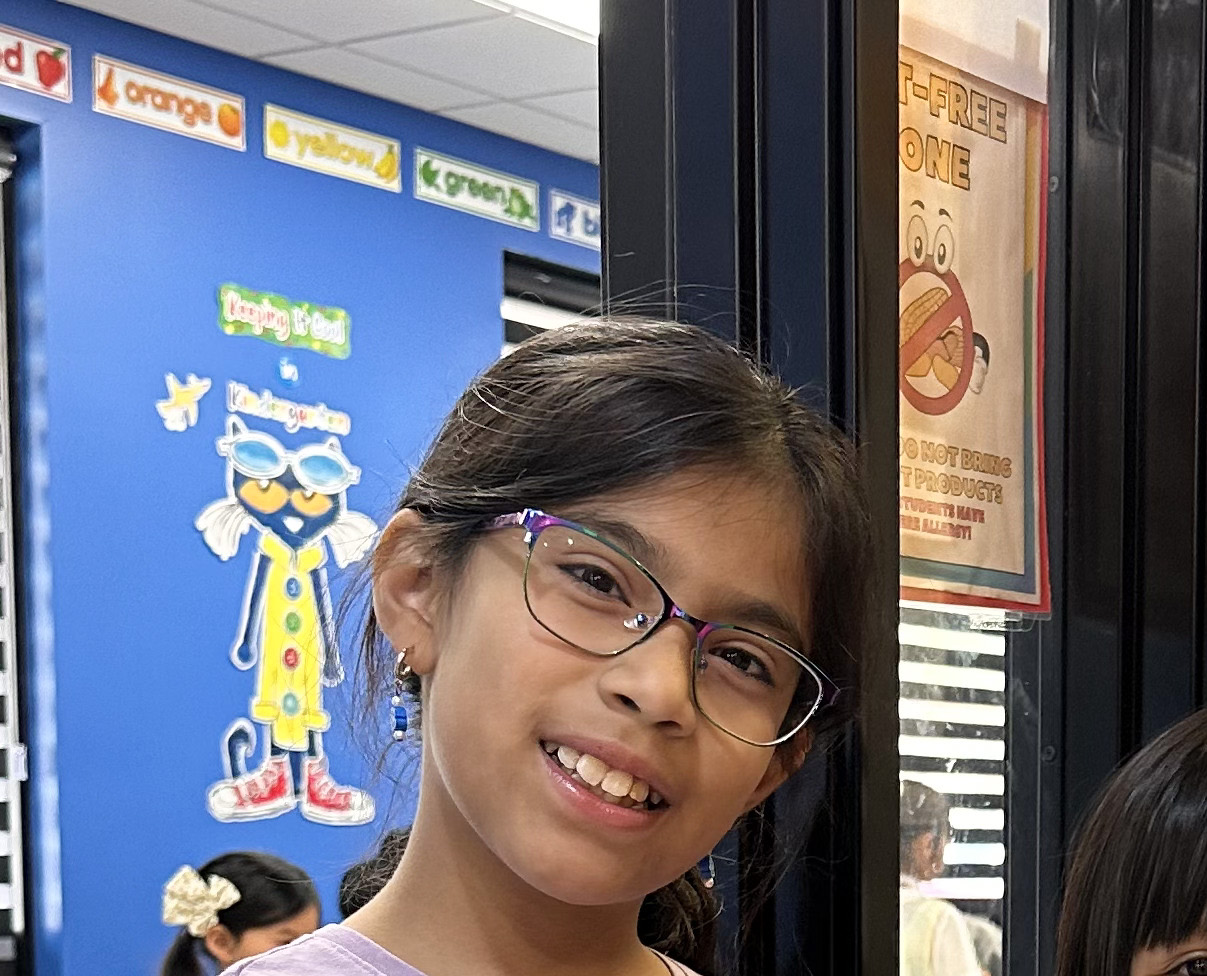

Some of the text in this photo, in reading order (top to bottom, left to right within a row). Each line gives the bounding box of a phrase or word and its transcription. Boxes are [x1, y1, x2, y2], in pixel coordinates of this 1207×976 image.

[124, 80, 212, 127] orange
[294, 131, 375, 168] yellow
[444, 171, 507, 205] green
[921, 440, 959, 468] NOT
[914, 467, 1003, 505] PRODUCTS
